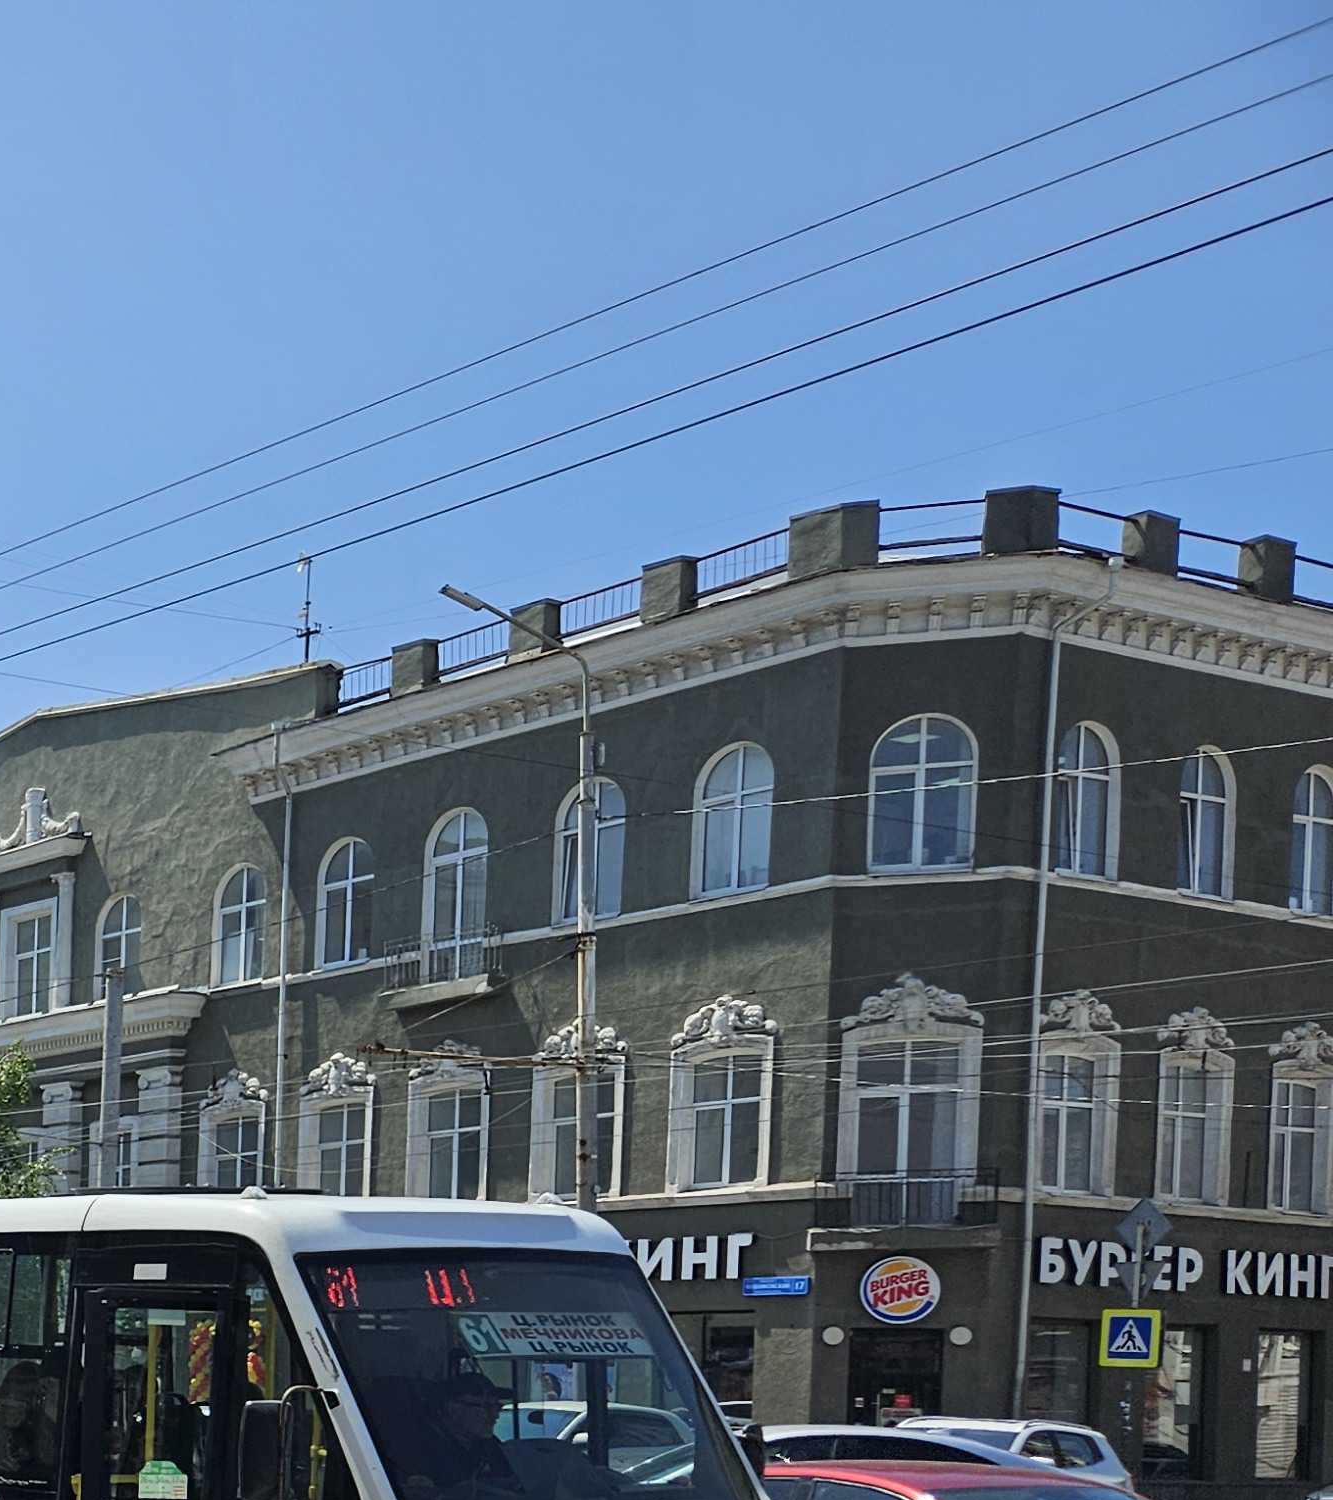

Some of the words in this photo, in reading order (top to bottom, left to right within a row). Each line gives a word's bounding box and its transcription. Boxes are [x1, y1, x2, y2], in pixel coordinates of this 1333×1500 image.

[636, 1232, 754, 1282] ИНГ
[1039, 1236, 1204, 1292] БУРЕР
[870, 1269, 928, 1292] BURGER
[872, 1281, 930, 1309] KING
[511, 1314, 617, 1327] Ц.РЫНОК
[458, 1317, 508, 1352] 61
[500, 1327, 645, 1340] МЕЧНИКОВА
[528, 1340, 634, 1354] Ц.РЫНОК
